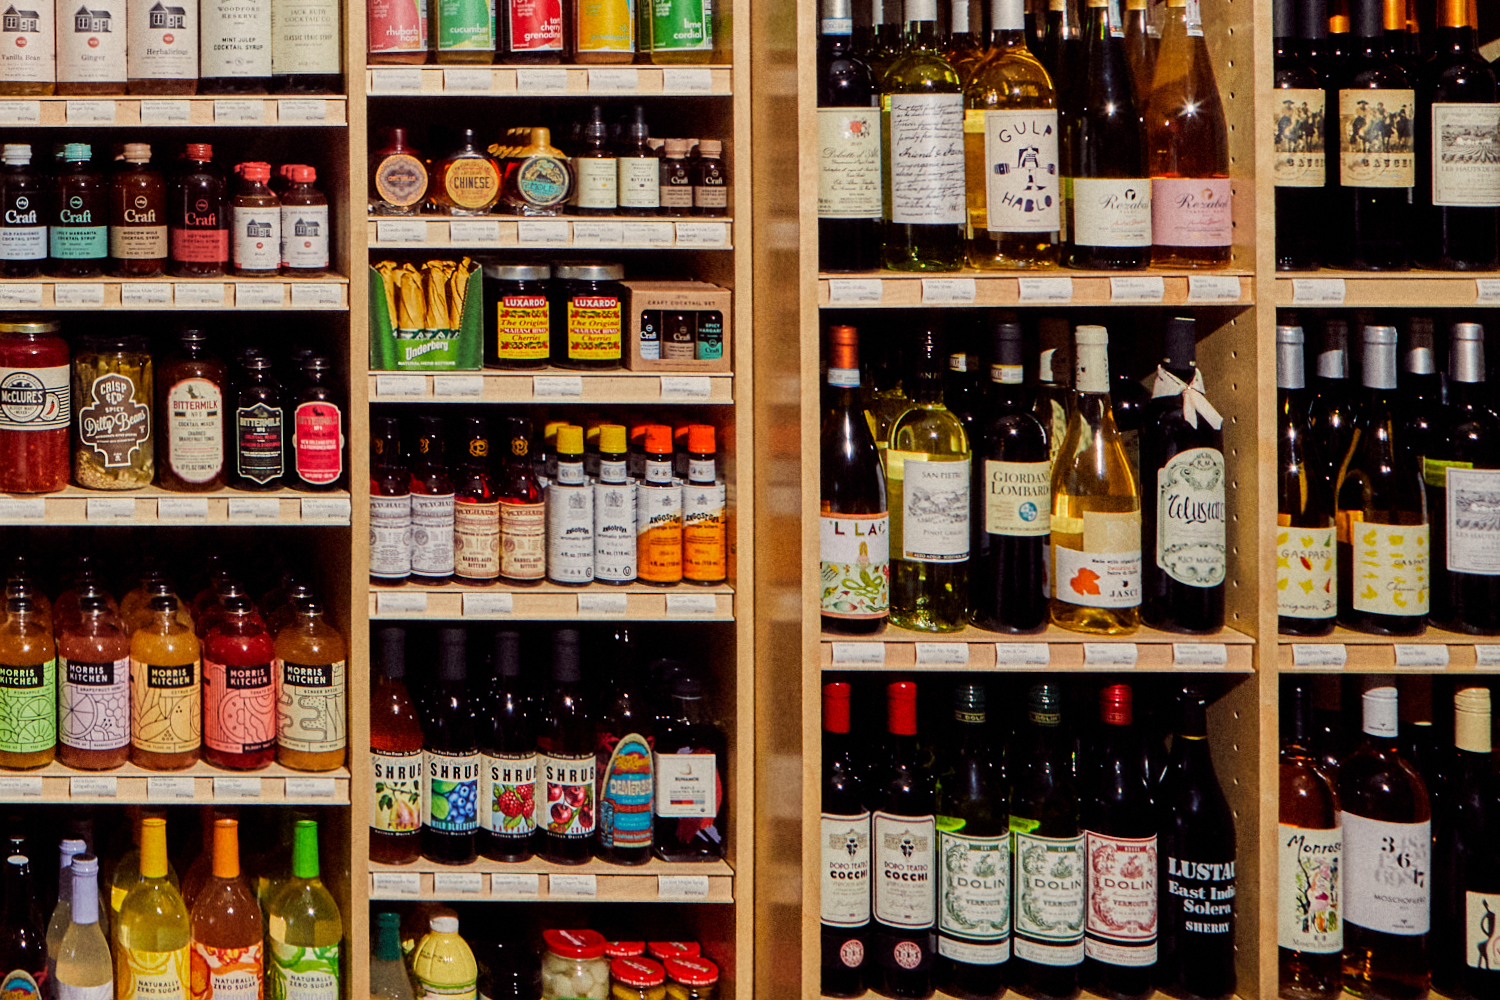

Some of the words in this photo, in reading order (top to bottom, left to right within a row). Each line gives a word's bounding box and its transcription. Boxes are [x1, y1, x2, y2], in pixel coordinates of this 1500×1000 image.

[683, 18, 702, 29] lime
[386, 25, 419, 36] rhubarb
[673, 27, 702, 39] cordial
[400, 34, 419, 42] hops
[471, 33, 488, 42] mint
[80, 53, 106, 62] Ginger
[453, 176, 490, 189] CHINESE
[1001, 192, 1052, 213] HABLO
[5, 210, 37, 224] Craft
[60, 210, 92, 224] Craft
[124, 209, 156, 223] Craft
[185, 212, 217, 226] Craft
[505, 298, 545, 307] LUXARDO
[575, 298, 617, 307] LUXARDO
[501, 319, 516, 327] The
[517, 319, 548, 329] Original
[571, 319, 586, 327] The
[587, 319, 619, 329] Original
[511, 334, 541, 342] Cherries
[581, 334, 612, 342] Cherries
[405, 340, 449, 362] Underberg
[100, 381, 126, 395] CRISP
[173, 400, 218, 410] BITTERMILK
[0, 668, 35, 677] MORRIS
[70, 665, 104, 675] MORRIS
[151, 668, 187, 677] MORRIS
[230, 669, 264, 678] MORRIS
[287, 666, 322, 675] MORRIS
[0, 676, 38, 685] KITCHEN
[70, 674, 108, 683] KITCHEN
[151, 676, 191, 685] KITCHEN
[230, 676, 268, 685] KITCHEN
[287, 674, 327, 684] KITCHEN
[430, 763, 479, 780] SHRUB
[546, 766, 595, 783] SHRUB
[830, 869, 868, 880] COCCHI
[884, 869, 928, 880] COCCHI
[958, 877, 1005, 889] DOLIN
[1034, 878, 1082, 889] DOLIN
[1104, 878, 1153, 890] DOLIN
[1168, 881, 1206, 899] East
[1184, 899, 1232, 915] Solera
[1185, 920, 1230, 933] SHERRY
[137, 979, 179, 989] NATURALLY
[213, 983, 231, 991] ZERO
[233, 981, 256, 991] SUGAR
[214, 976, 255, 987] NATURALLY
[136, 986, 155, 994] ZERO
[156, 985, 179, 994] SUGAR
